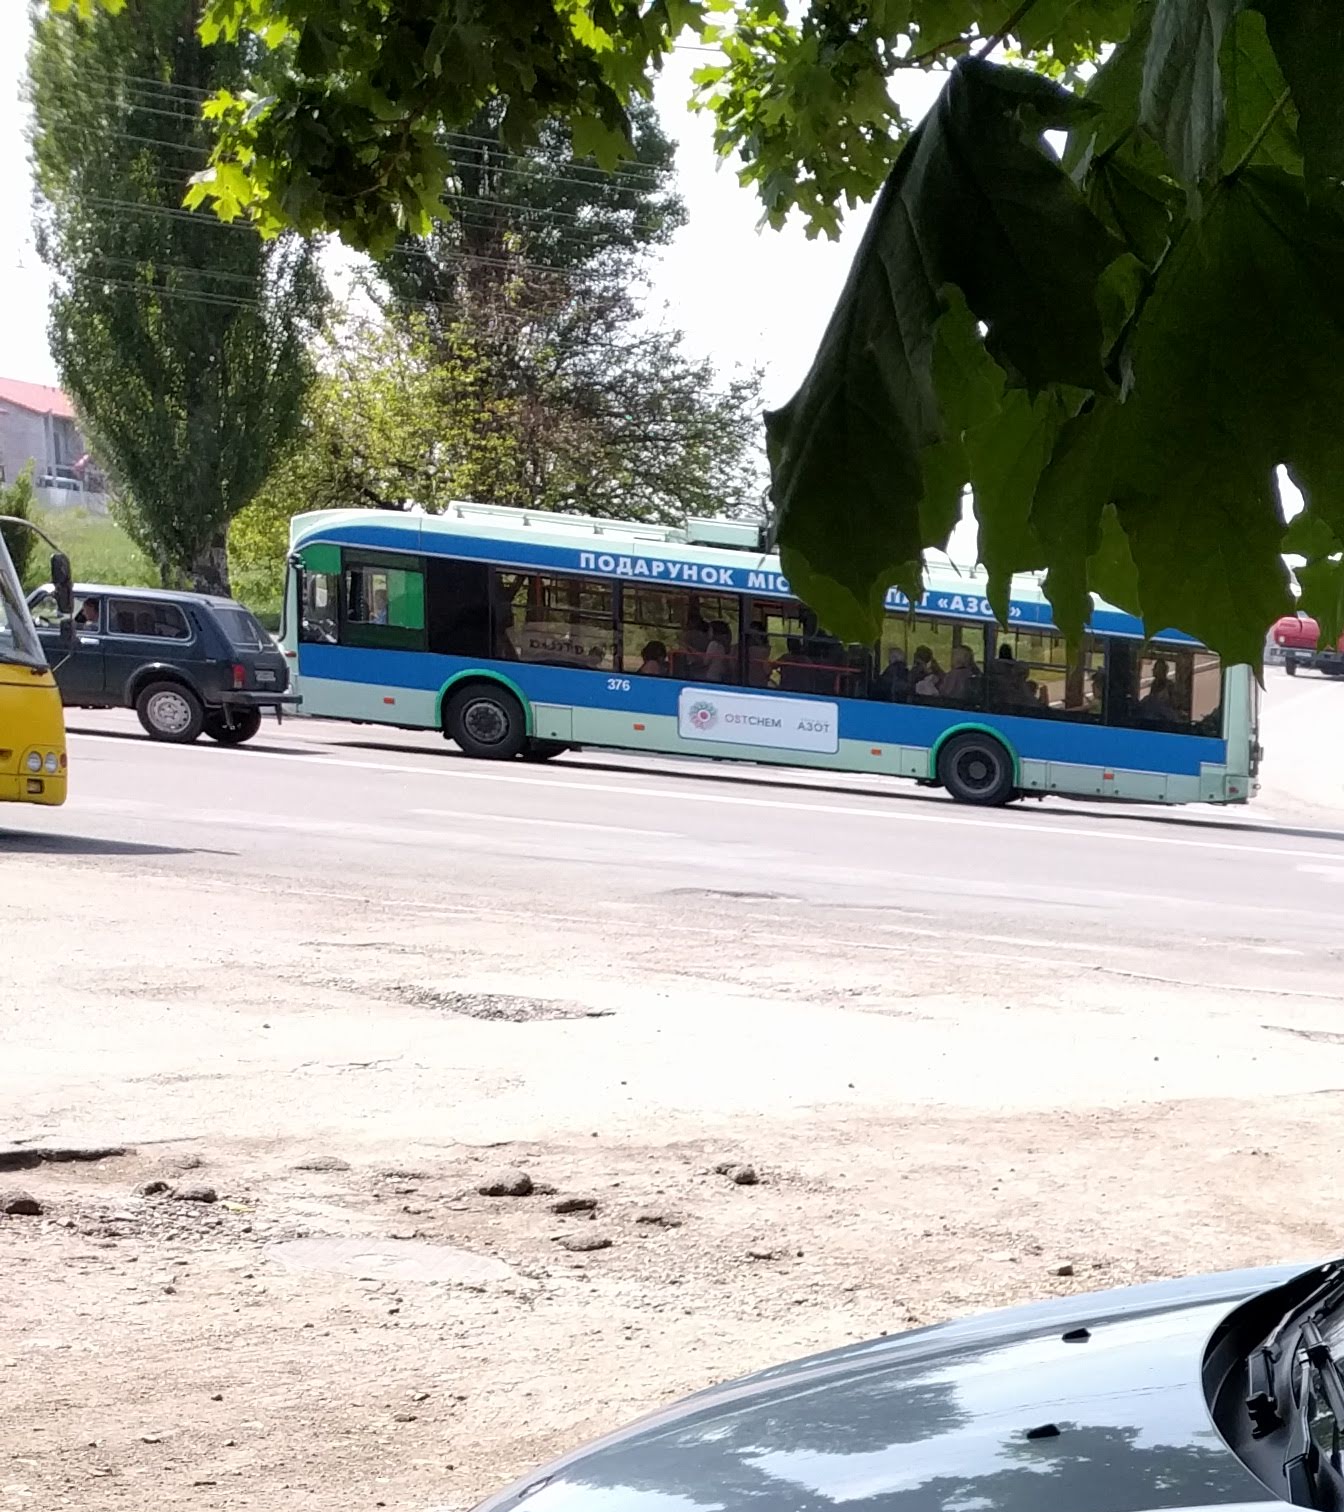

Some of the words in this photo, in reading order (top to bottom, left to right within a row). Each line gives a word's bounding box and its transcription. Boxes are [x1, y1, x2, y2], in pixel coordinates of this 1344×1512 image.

[580, 552, 734, 586] ПОДАРУНОК
[747, 571, 790, 592] МІС
[937, 595, 1022, 617] «АЗО»
[607, 678, 631, 692] 376
[725, 713, 782, 728] OSTCHEM
[797, 721, 830, 733] АЗОТ
